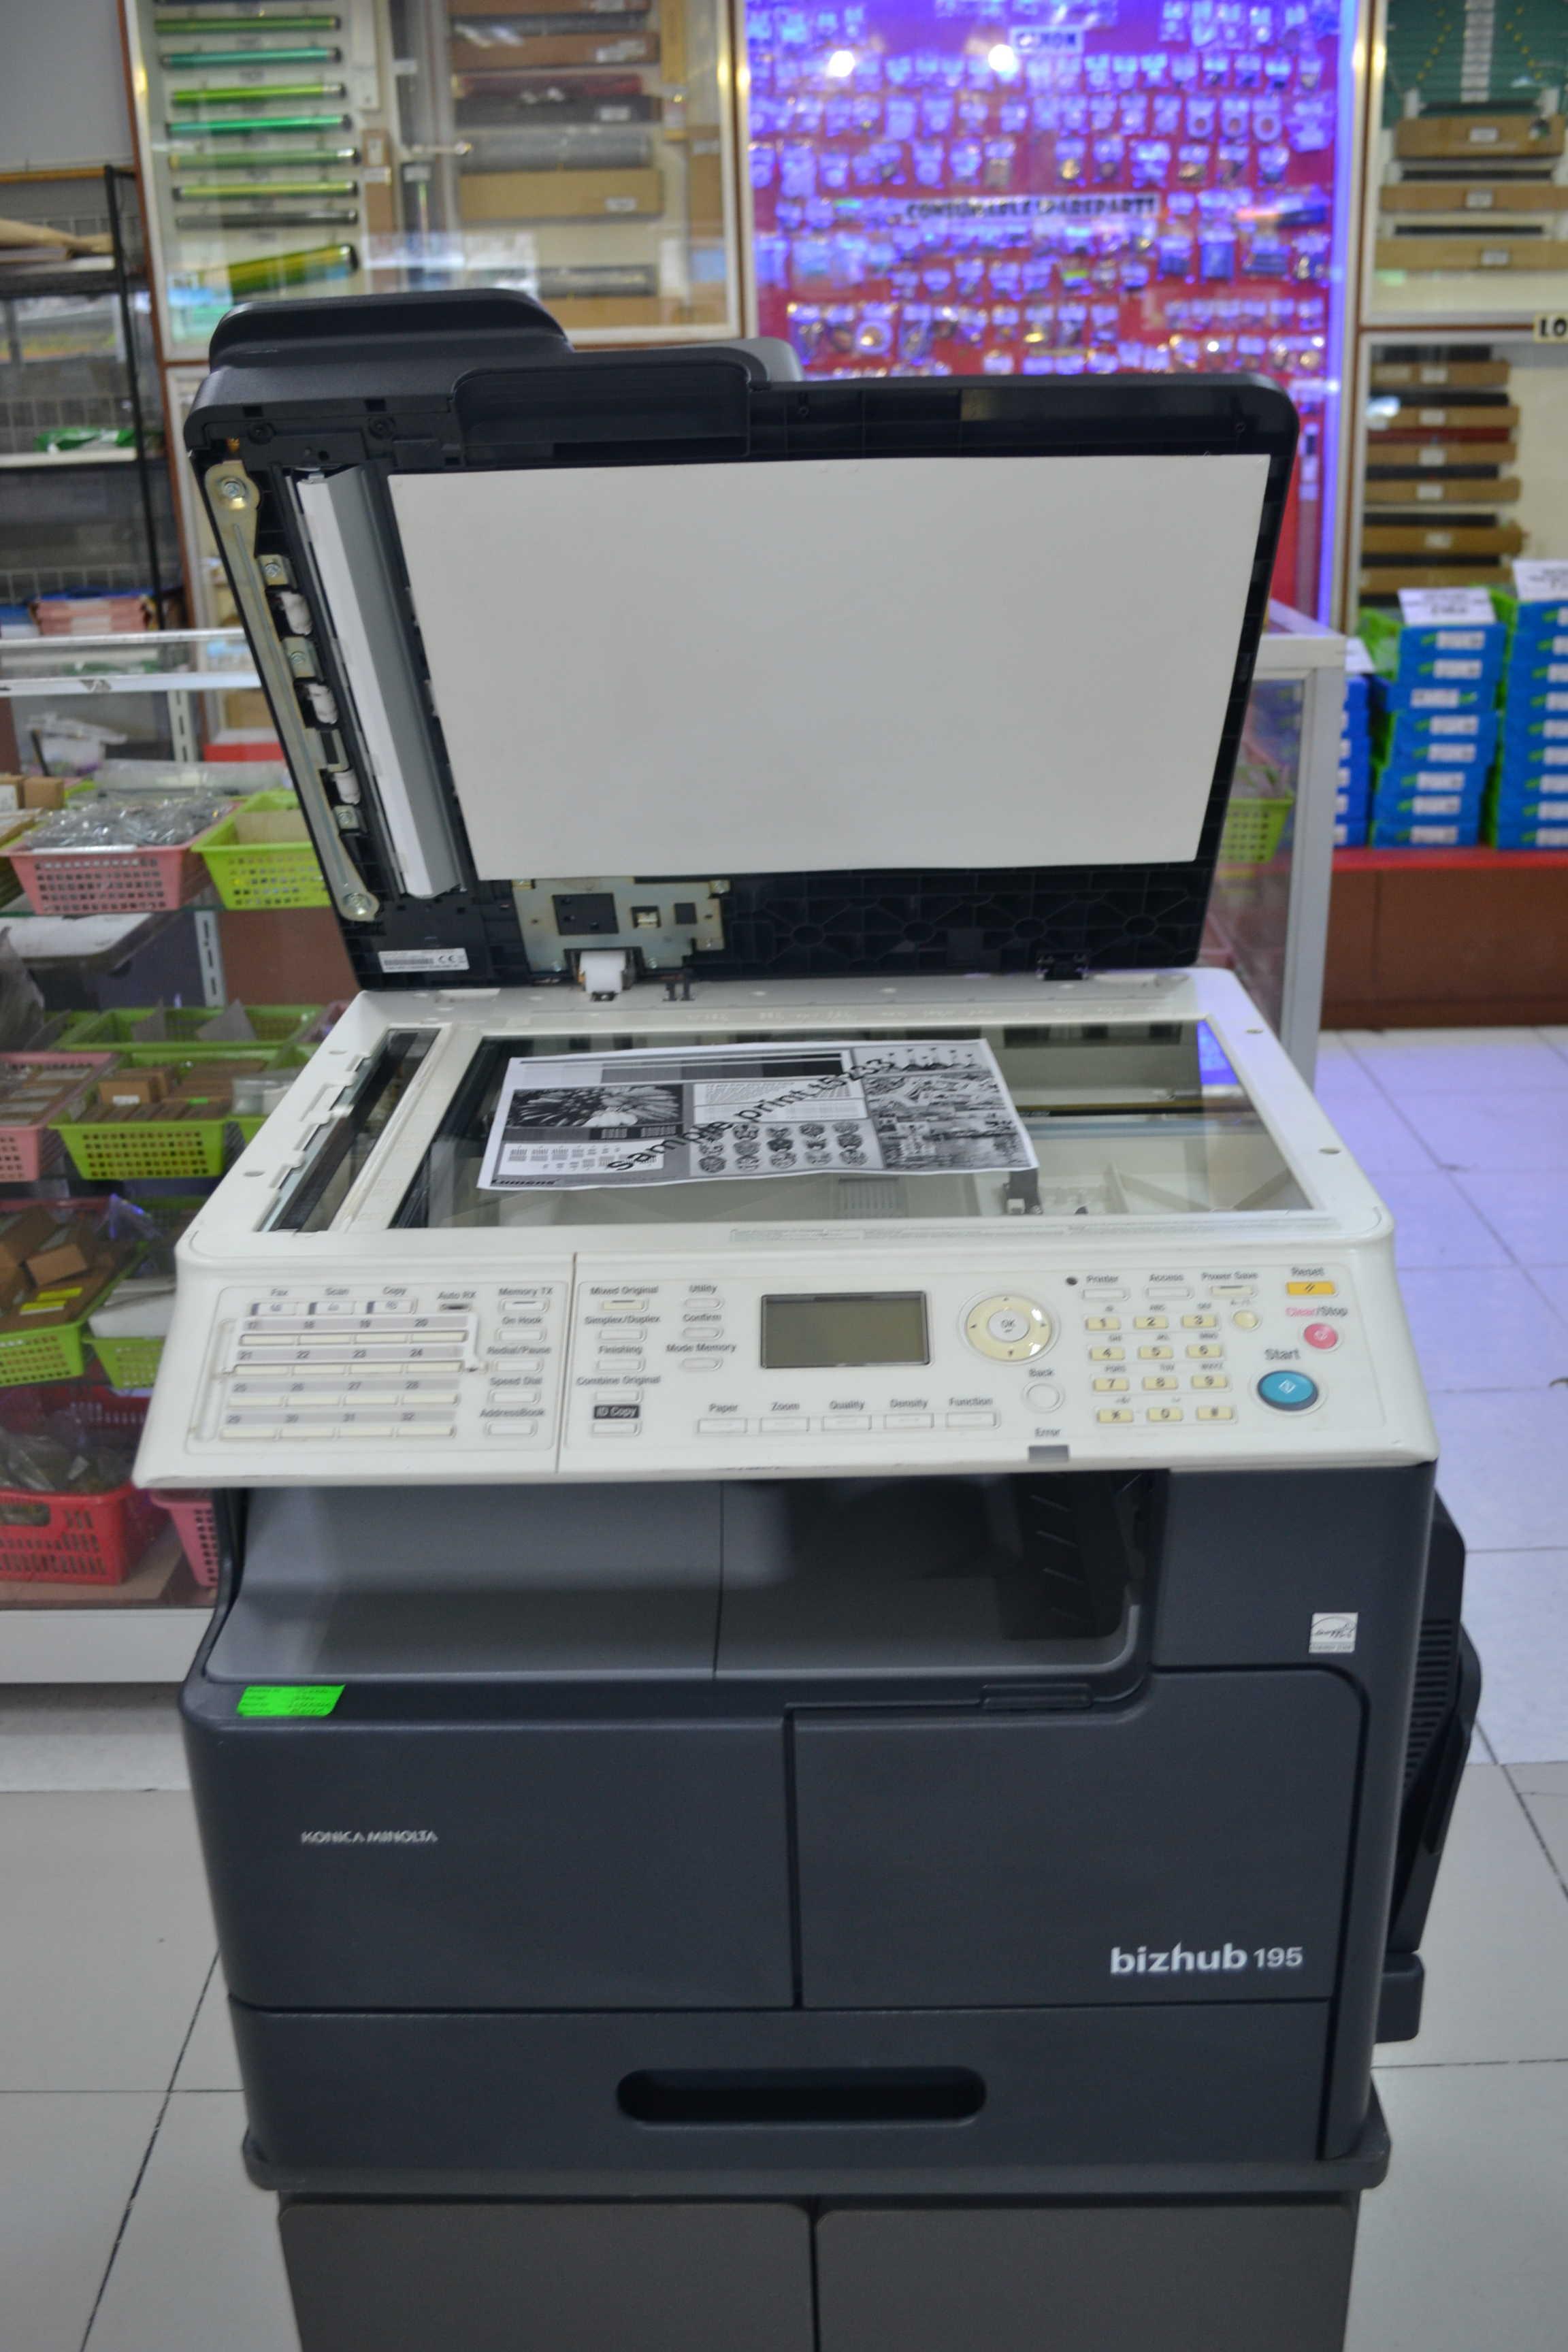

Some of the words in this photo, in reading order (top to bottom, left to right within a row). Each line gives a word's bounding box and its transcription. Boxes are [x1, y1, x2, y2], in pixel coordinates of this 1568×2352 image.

[606, 1121, 734, 1172] sample
[736, 1088, 806, 1124] print
[1291, 1267, 1324, 1277] Reset
[1087, 1275, 1119, 1284] Printer
[1149, 1274, 1184, 1282] Access
[270, 1288, 289, 1296] Fax
[325, 1287, 350, 1296] Scan
[382, 1286, 407, 1296] Copy
[498, 1287, 538, 1297] Memory
[541, 1287, 554, 1295] TX
[589, 1286, 619, 1295] Mixed
[621, 1286, 659, 1296] Original
[689, 1284, 718, 1294] Utility
[437, 1292, 460, 1300] Auto
[1286, 1306, 1348, 1318] Clear/Stop
[414, 1318, 429, 1327] 20
[502, 1316, 516, 1325] On
[585, 1315, 661, 1326] Simplex/Duplex
[683, 1313, 722, 1322] Confirm
[1098, 1318, 1106, 1327] 1
[1146, 1317, 1156, 1326] 2
[1195, 1316, 1204, 1325] 3
[247, 1320, 258, 1329] 17
[304, 1320, 315, 1329] 18
[359, 1319, 372, 1328] 19
[1000, 1319, 1015, 1328] OK
[352, 1349, 367, 1358] 23
[408, 1348, 423, 1358] 24
[487, 1346, 552, 1355] Redial/Pause
[598, 1345, 643, 1355] Finishing
[666, 1344, 693, 1353] Mode
[696, 1343, 737, 1354] Memory
[1102, 1348, 1111, 1358] 4
[1199, 1345, 1209, 1355] 6
[239, 1350, 252, 1360] 21
[296, 1350, 310, 1359] 22
[1264, 1348, 1301, 1360] Start
[1028, 1368, 1054, 1377] Back
[405, 1380, 420, 1390] 28
[489, 1377, 521, 1387] Speed
[523, 1376, 543, 1385] Dial
[576, 1376, 620, 1386] Combine
[622, 1375, 661, 1386] Original
[1107, 1378, 1115, 1388] 7
[1156, 1377, 1165, 1387] 8
[1205, 1375, 1214, 1386] 9
[233, 1382, 247, 1392] 25
[290, 1382, 305, 1392] 26
[348, 1381, 362, 1391] 27
[770, 1401, 800, 1412] Zoom
[829, 1399, 865, 1411] Quality
[889, 1398, 928, 1409] Density
[948, 1396, 993, 1407] Function
[595, 1406, 608, 1418] ID
[610, 1406, 638, 1418] Copy
[708, 1403, 738, 1414] Paper
[226, 1414, 242, 1424] 29
[284, 1414, 299, 1424] 30
[342, 1413, 356, 1422] 31
[401, 1412, 415, 1422] 32
[1034, 1427, 1060, 1437] Error
[301, 1830, 365, 1843] KONICA
[366, 1829, 439, 1843] MINOLTA
[1109, 1940, 1247, 1974] bizhub
[1253, 1946, 1304, 1969] 195
